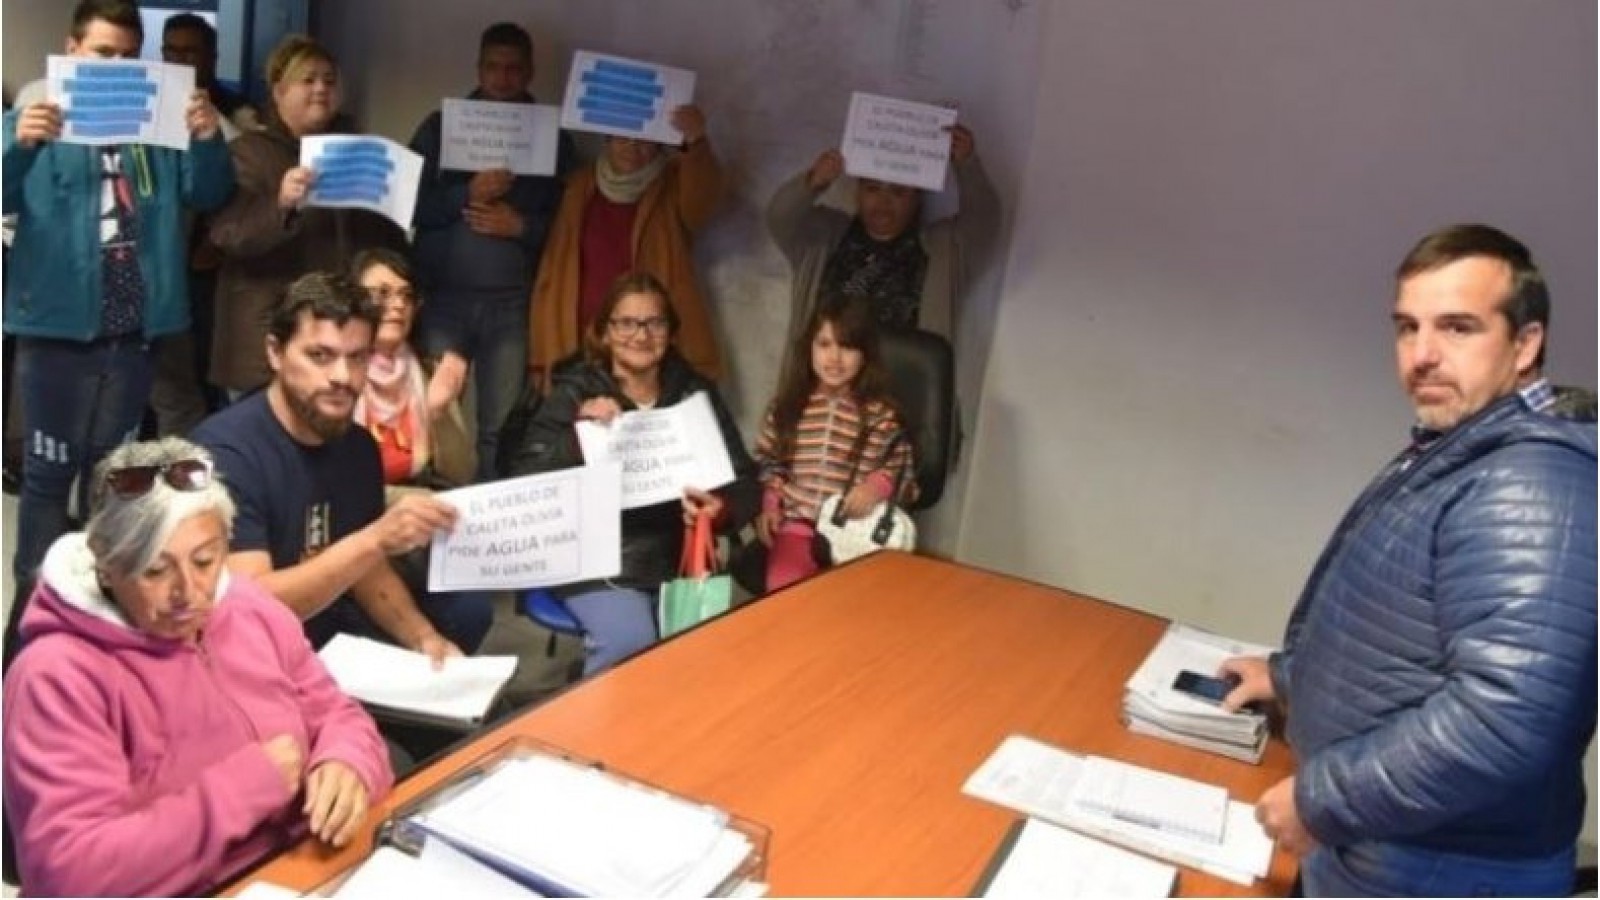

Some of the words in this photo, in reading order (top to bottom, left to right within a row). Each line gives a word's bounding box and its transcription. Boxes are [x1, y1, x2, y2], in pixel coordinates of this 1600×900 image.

[878, 140, 916, 154] AGUA
[621, 457, 663, 473] AGUA
[470, 501, 485, 516] EL
[488, 489, 541, 510] PUEBLO
[543, 486, 559, 500] DE
[466, 516, 518, 535] CALETA
[521, 507, 563, 526] OLIVIA
[448, 544, 480, 558] PIDE
[486, 534, 539, 556] AGUA
[544, 531, 578, 547] PARA
[480, 562, 499, 576] SU
[503, 559, 547, 576] GENTE
